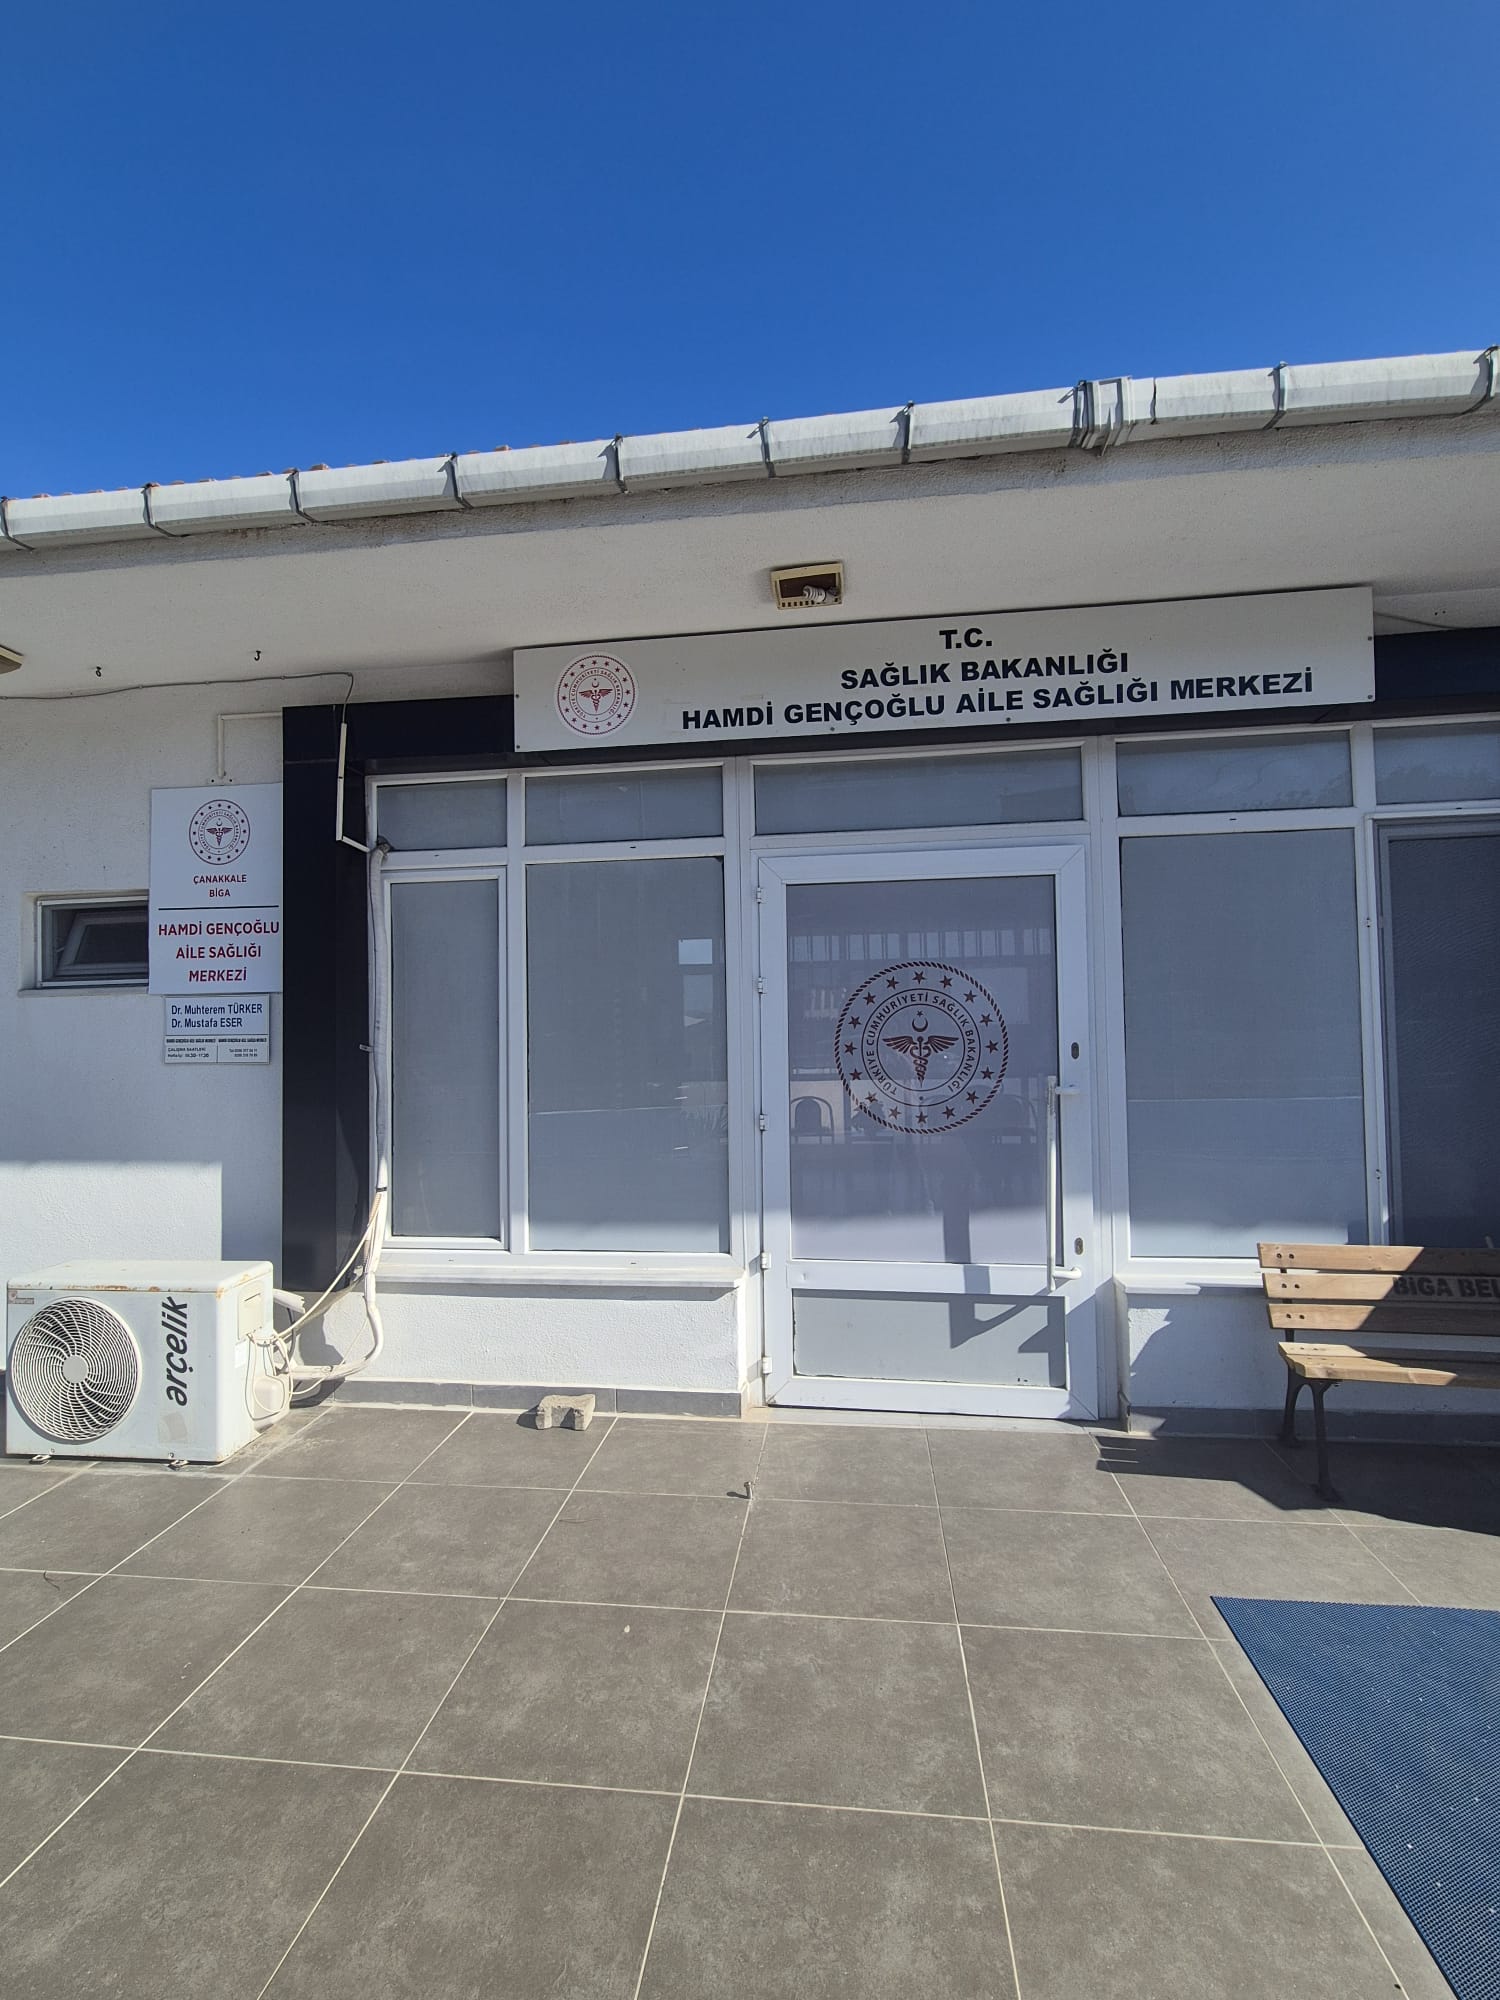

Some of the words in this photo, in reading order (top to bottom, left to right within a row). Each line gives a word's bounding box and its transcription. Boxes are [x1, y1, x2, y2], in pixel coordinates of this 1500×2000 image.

[939, 628, 993, 650] T.C.
[840, 662, 951, 690] SAĞLIK
[960, 648, 1129, 682] BAKANLIĞI
[682, 701, 774, 730] HAMDİ
[783, 694, 946, 726] GENÇOĞLU
[956, 687, 1024, 714] AİLE
[1032, 677, 1159, 709] SAĞLIĞI
[1170, 666, 1314, 701] MERKEZİ
[193, 874, 247, 885] ÇANAKKALE
[209, 887, 231, 898] BİGA
[158, 921, 202, 936] HAMDİ
[206, 918, 280, 937] GENÇOĞLU
[175, 944, 206, 959] AİLE
[208, 942, 261, 959] SAĞLIĞI
[188, 966, 247, 982] MERKEZİ
[171, 1005, 183, 1015] Dr.
[184, 1004, 226, 1015] Muhterem
[227, 1001, 263, 1014] TÜRKER
[866, 991, 929, 1046] CUMHURİYETİ
[931, 995, 970, 1028] SAĞLIK
[171, 1018, 183, 1028] Dr.
[184, 1017, 218, 1028] Mustafa
[220, 1017, 243, 1028] ESER
[947, 1029, 977, 1093] BAKANLIĞI
[866, 1050, 898, 1096] TÜRKİYE
[161, 1296, 194, 1407] arçelik
